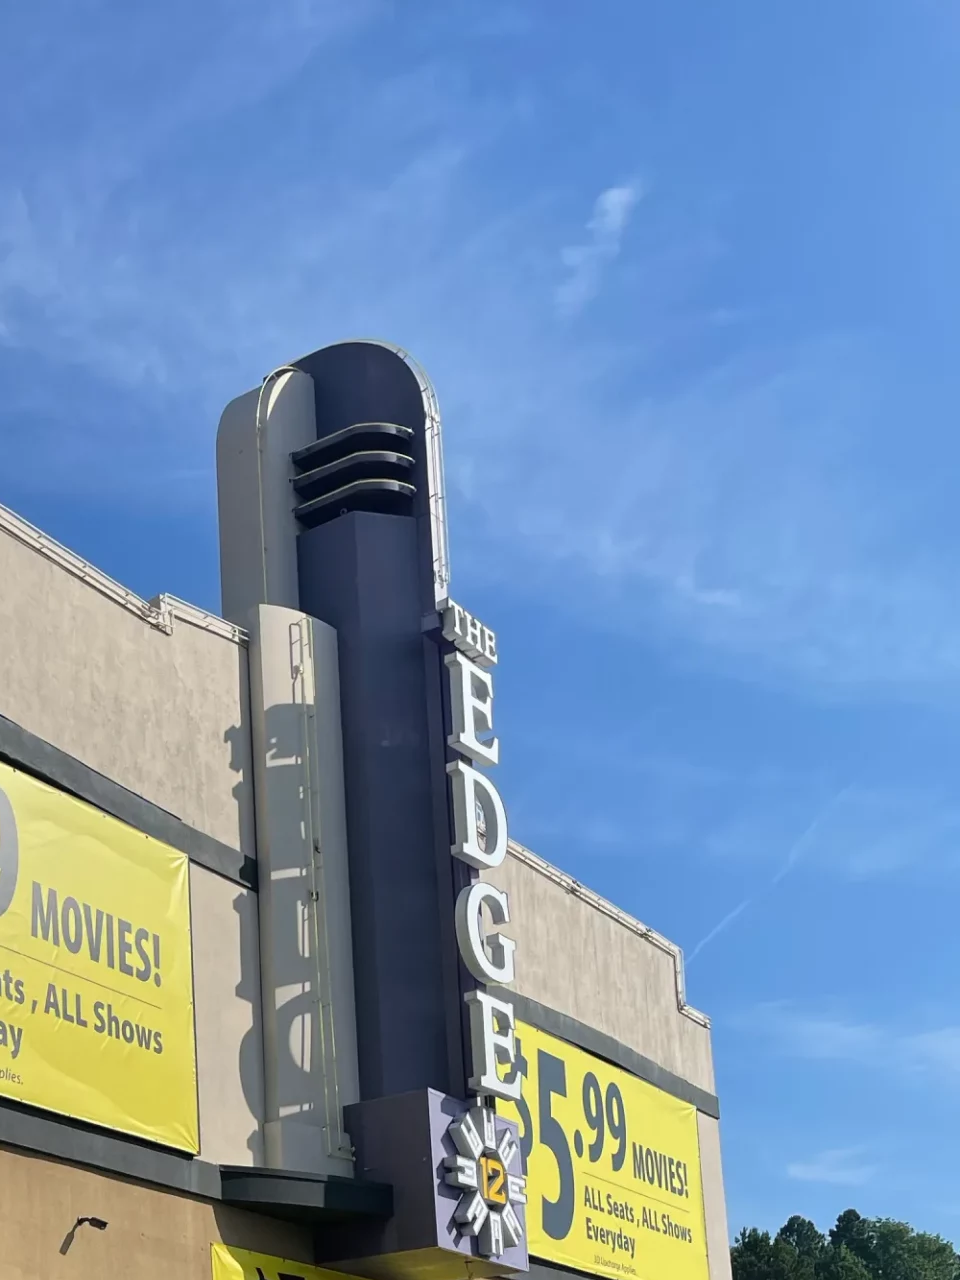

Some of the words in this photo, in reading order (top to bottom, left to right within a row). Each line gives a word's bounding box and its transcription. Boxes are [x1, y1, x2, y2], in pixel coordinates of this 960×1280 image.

[445, 597, 498, 665] THE
[445, 650, 522, 1100] EDGE
[30, 880, 162, 988] MOVIES!
[44, 983, 88, 1028] ALL
[93, 1001, 163, 1054] Shows
[480, 1156, 507, 1205] 12
[633, 1142, 690, 1199] MOVIES!
[584, 1185, 605, 1213] ALL
[642, 1206, 661, 1233] ALL
[661, 1213, 693, 1244] Shows
[585, 1217, 636, 1260] Everyday
